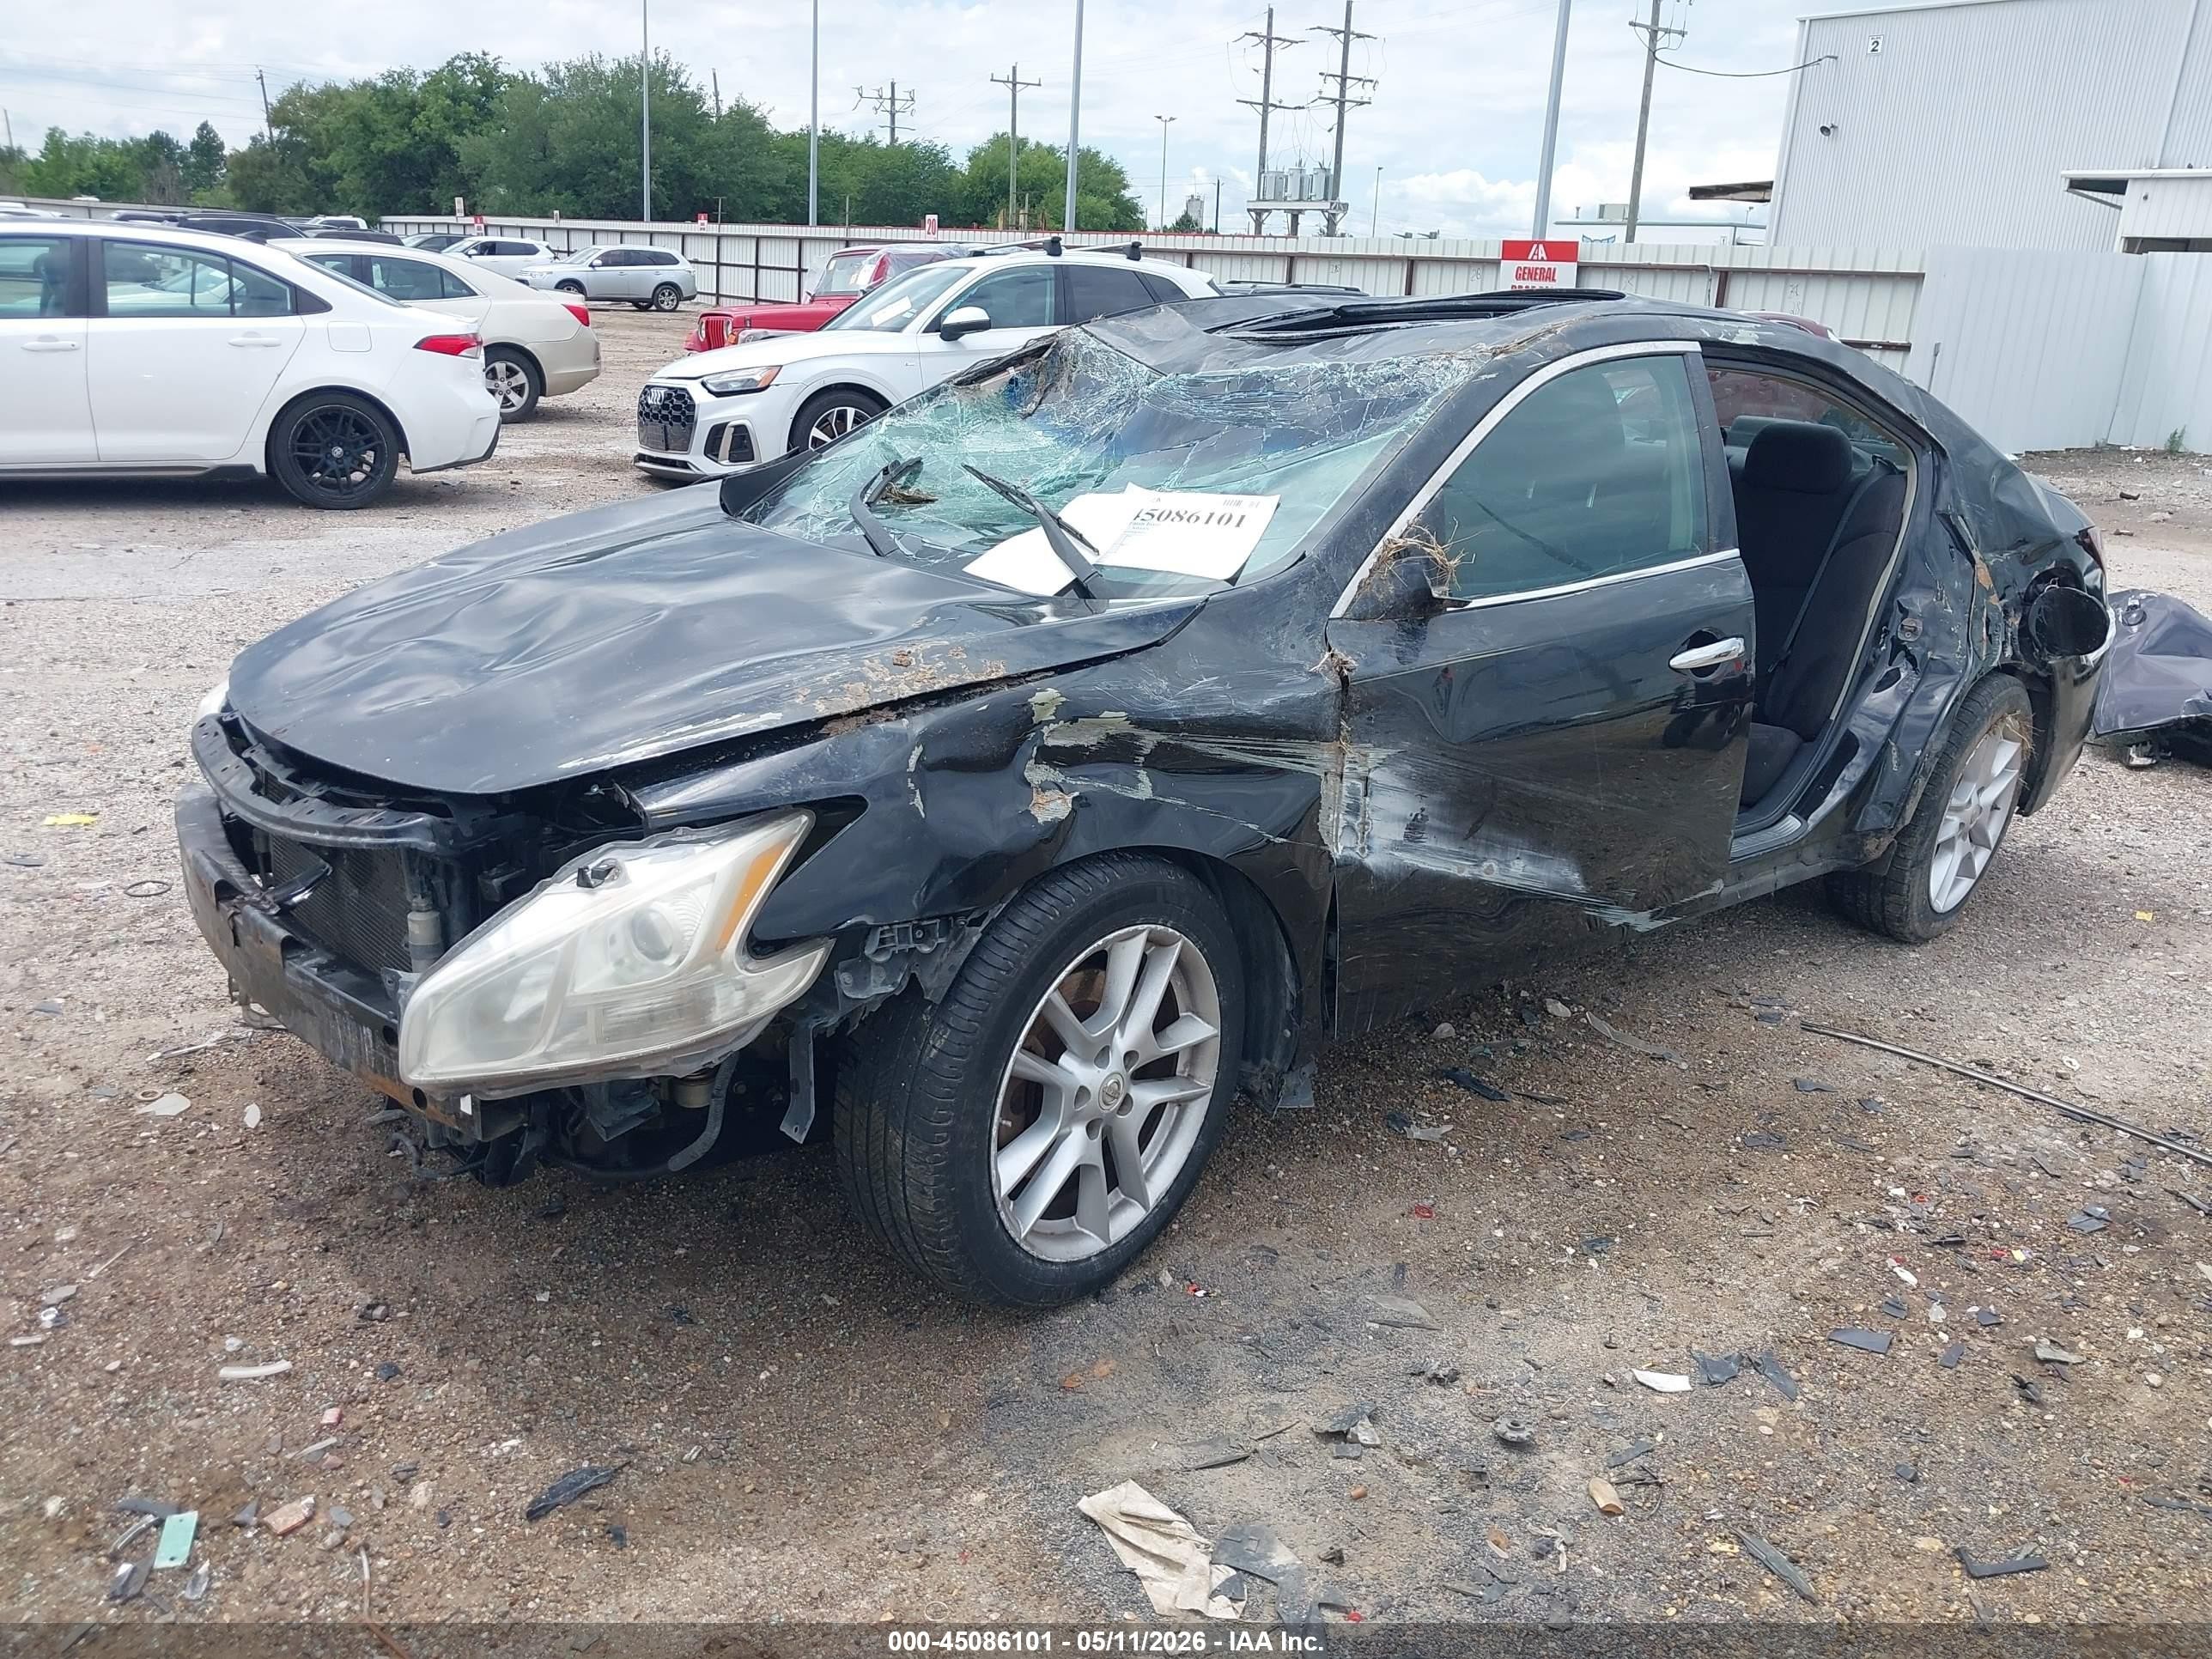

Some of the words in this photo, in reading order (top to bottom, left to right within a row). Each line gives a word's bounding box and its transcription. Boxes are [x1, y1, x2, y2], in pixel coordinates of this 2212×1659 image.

[1870, 40, 1880, 52] 2
[927, 218, 937, 235] 20
[1516, 266, 1557, 283] GENERAL
